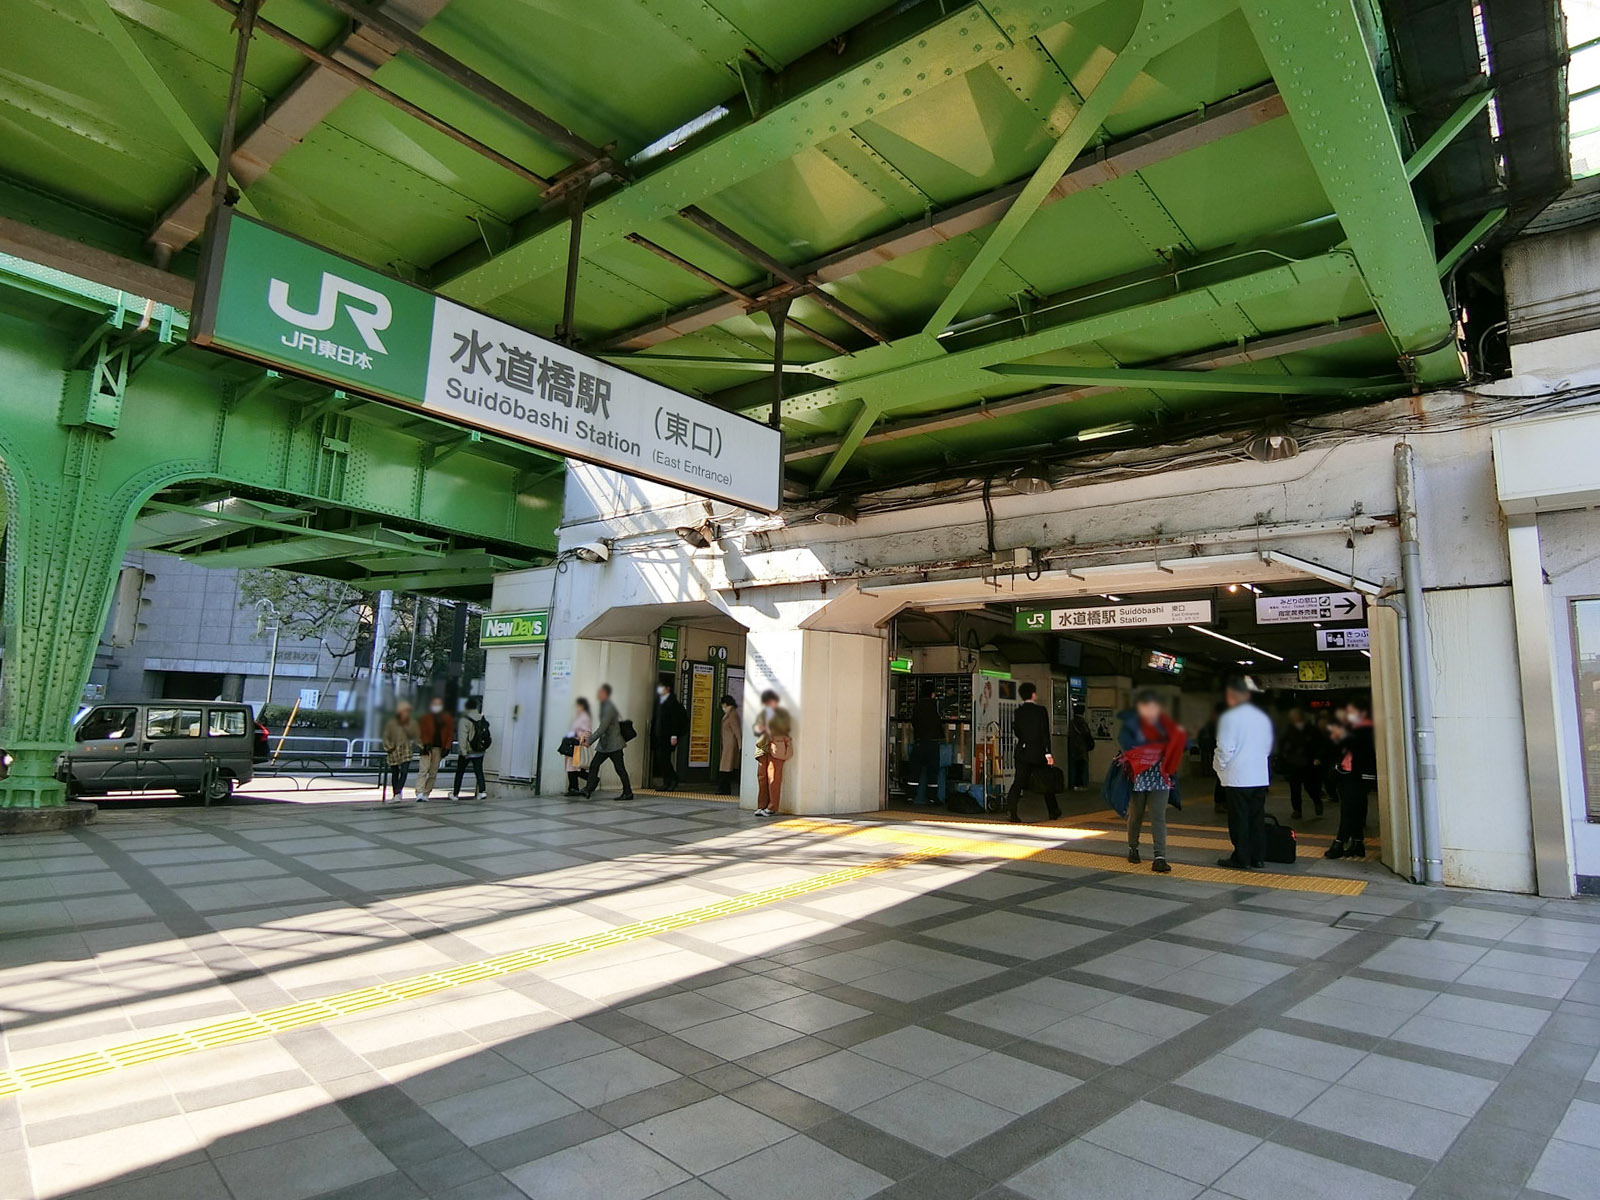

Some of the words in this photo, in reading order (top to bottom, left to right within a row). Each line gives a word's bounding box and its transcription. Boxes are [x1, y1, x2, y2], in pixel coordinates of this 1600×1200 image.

[268, 271, 393, 355] JR
[281, 330, 373, 370] JR東日本
[450, 329, 612, 420] 水道橋駅
[446, 377, 569, 434] Suidōbashi
[575, 420, 641, 457] Station
[652, 448, 681, 469] (East
[684, 460, 733, 486] Entrance)
[1280, 597, 1318, 605] みどりの窓口
[486, 618, 542, 637] NewDays
[1026, 613, 1045, 625] JR
[1058, 610, 1116, 627] 水道橋駅
[1119, 616, 1147, 624] Station
